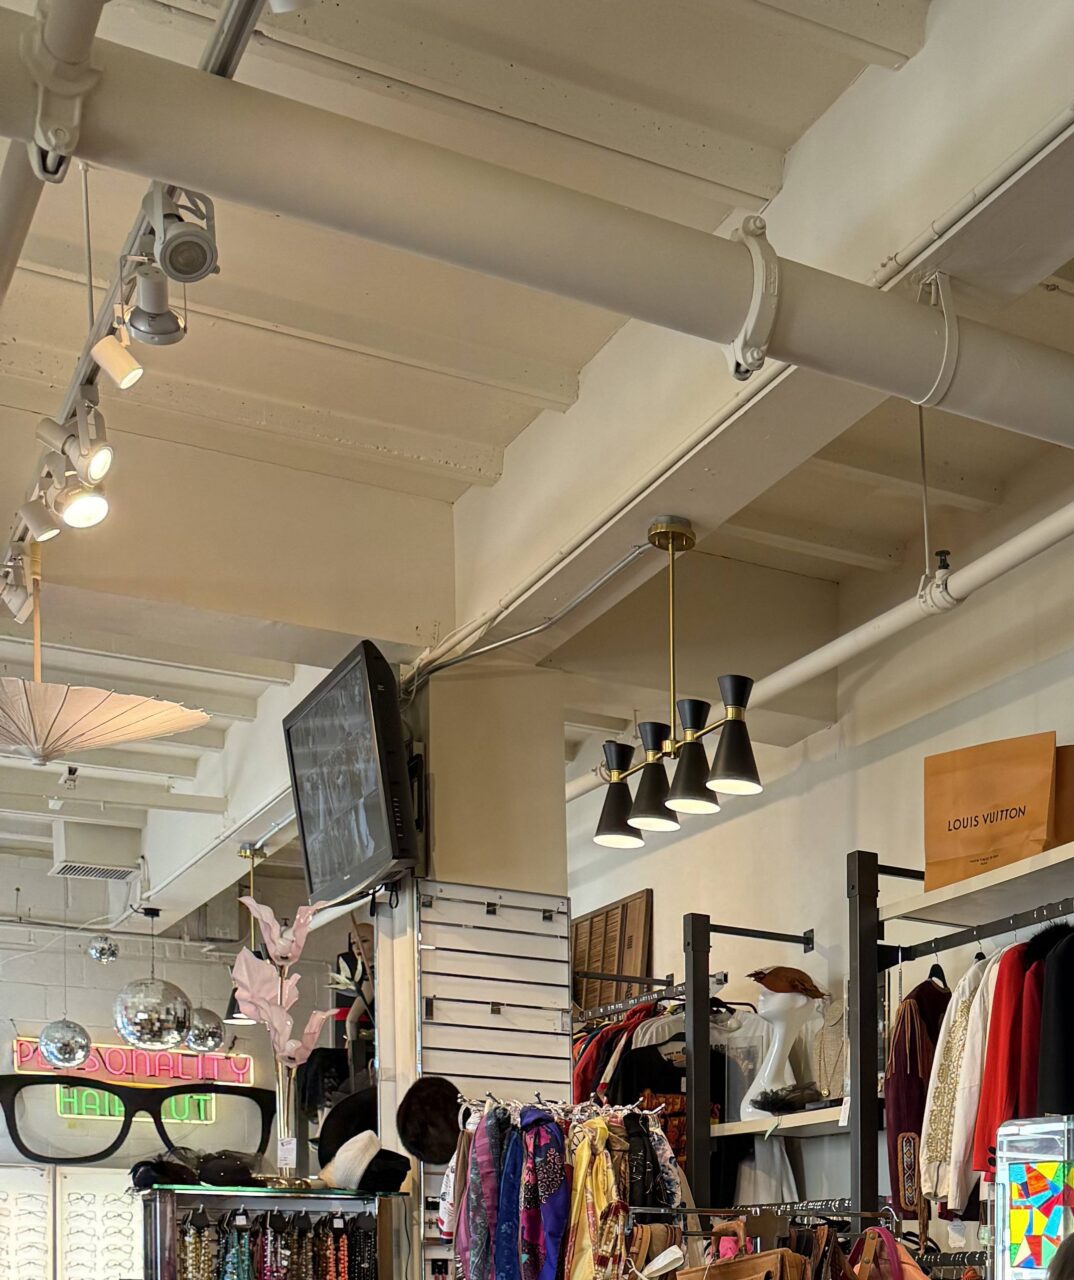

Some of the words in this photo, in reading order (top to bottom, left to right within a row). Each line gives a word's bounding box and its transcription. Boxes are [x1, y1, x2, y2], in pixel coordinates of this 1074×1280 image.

[947, 815, 979, 831] LOUIS
[982, 805, 1026, 825] VUITTON
[17, 1040, 250, 1083] PESONALITY
[60, 1086, 213, 1122] HAIUT
